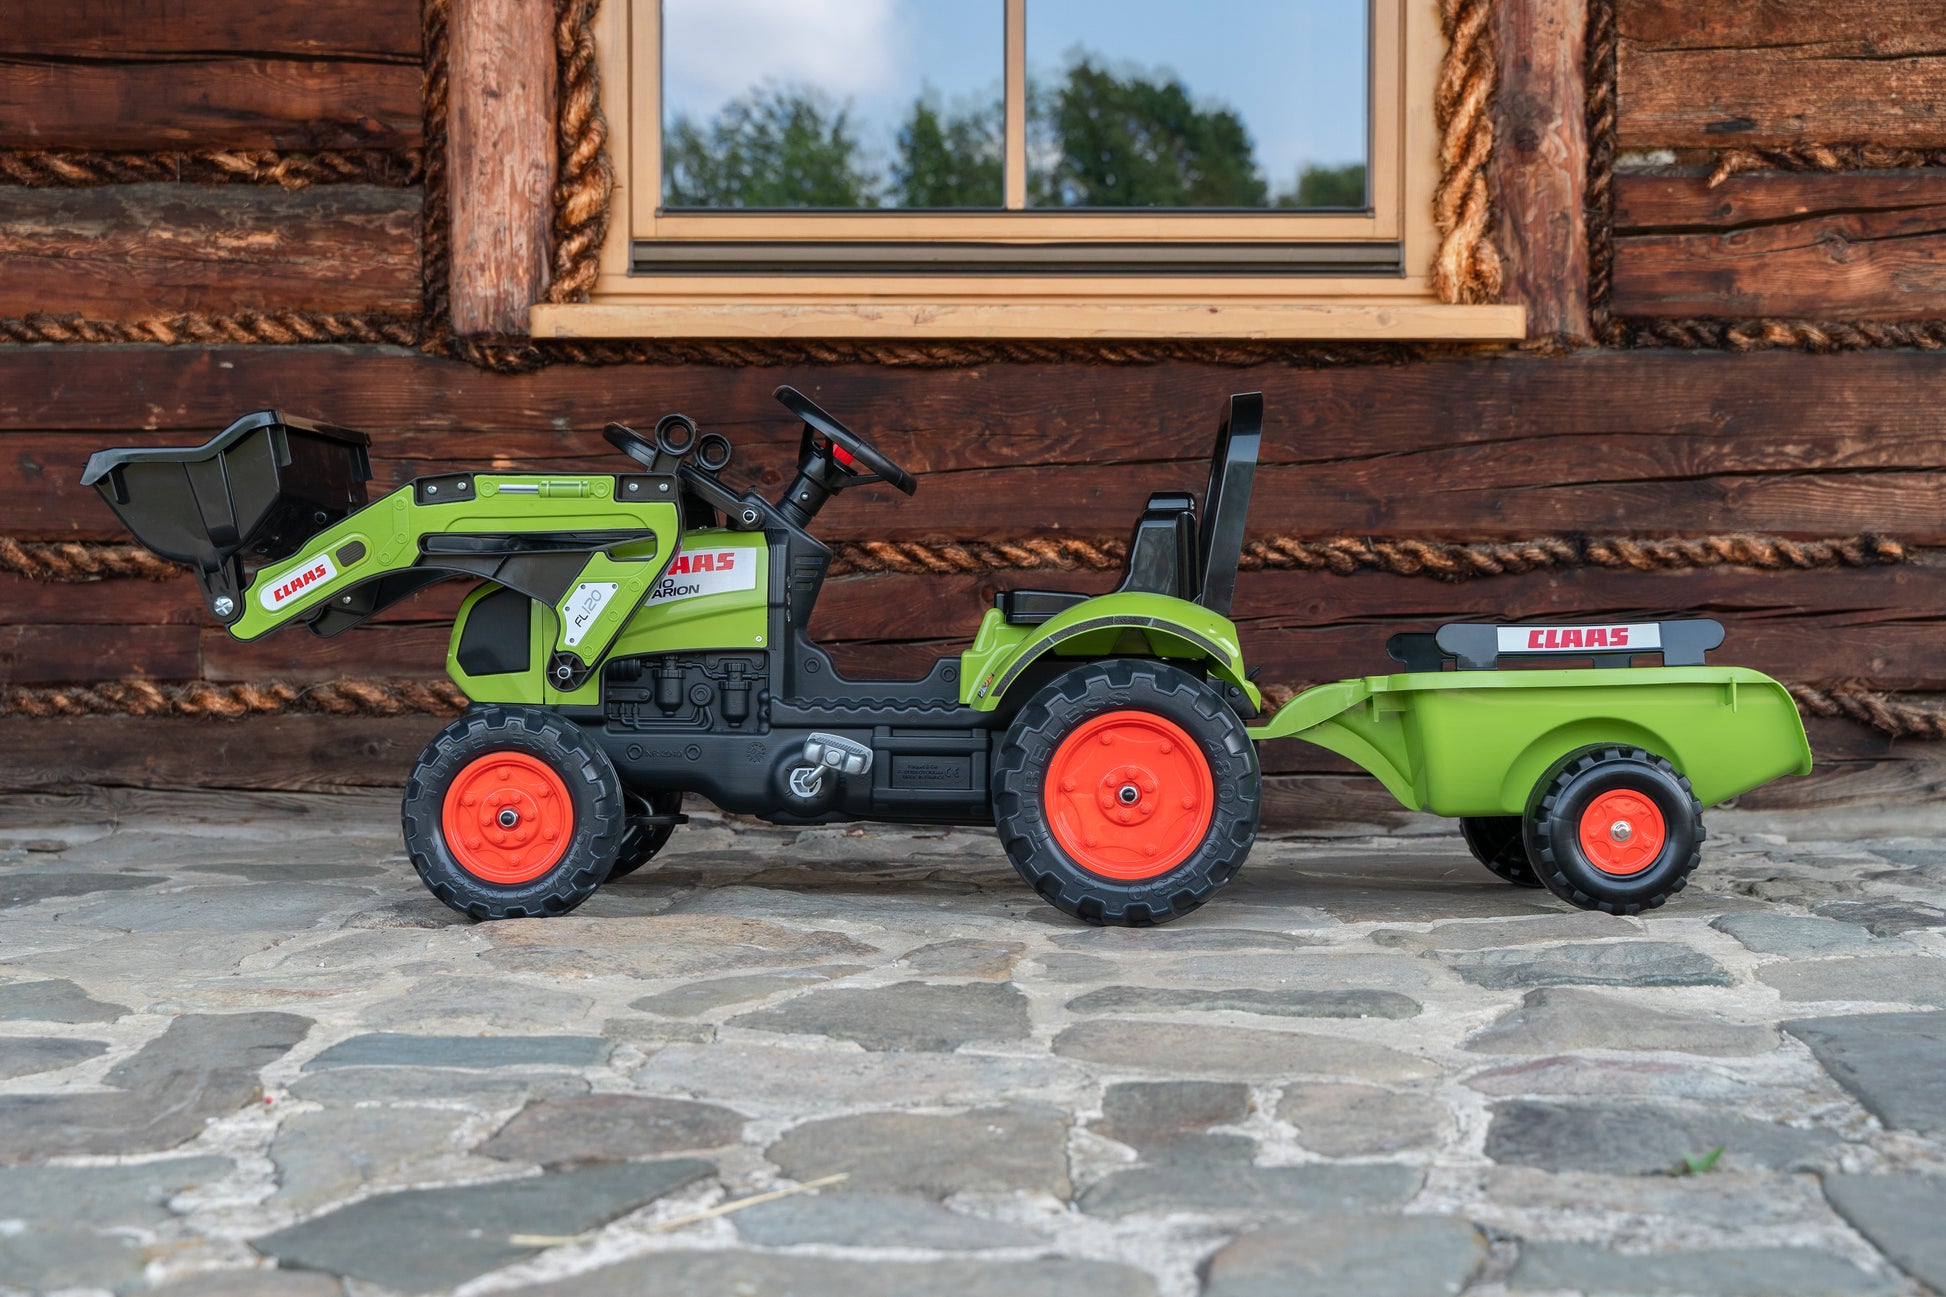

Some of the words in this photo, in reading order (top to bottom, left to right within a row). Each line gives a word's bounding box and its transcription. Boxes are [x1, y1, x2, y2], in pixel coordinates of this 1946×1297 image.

[273, 564, 327, 602] CLAAS
[651, 584, 700, 599] ARION
[574, 589, 602, 628] FL120
[1527, 627, 1629, 649] CLAAS
[1022, 691, 1131, 849] TUBELESS
